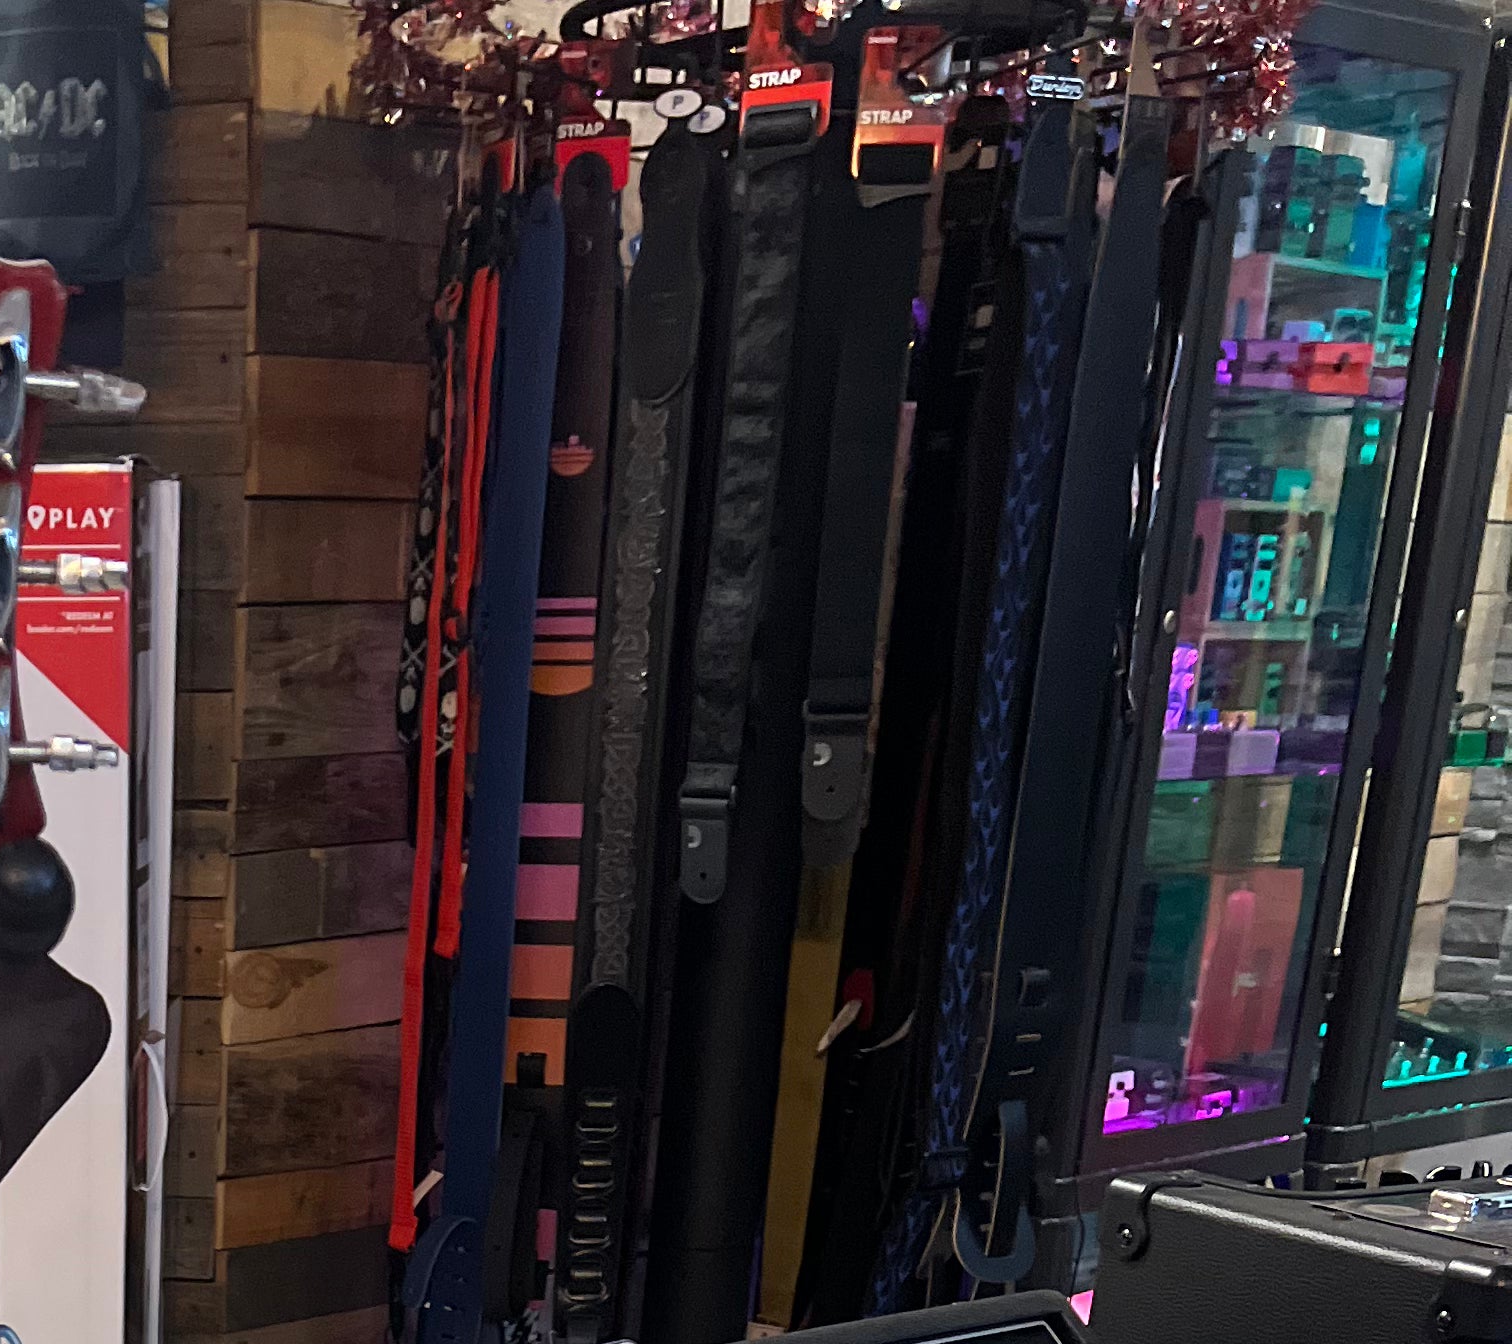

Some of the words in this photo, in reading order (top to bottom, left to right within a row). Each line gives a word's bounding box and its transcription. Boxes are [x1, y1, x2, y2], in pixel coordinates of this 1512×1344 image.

[749, 69, 801, 88] STRAP
[861, 110, 912, 124] STRAP
[556, 121, 605, 139] STRAP
[49, 507, 114, 529] PLAY
